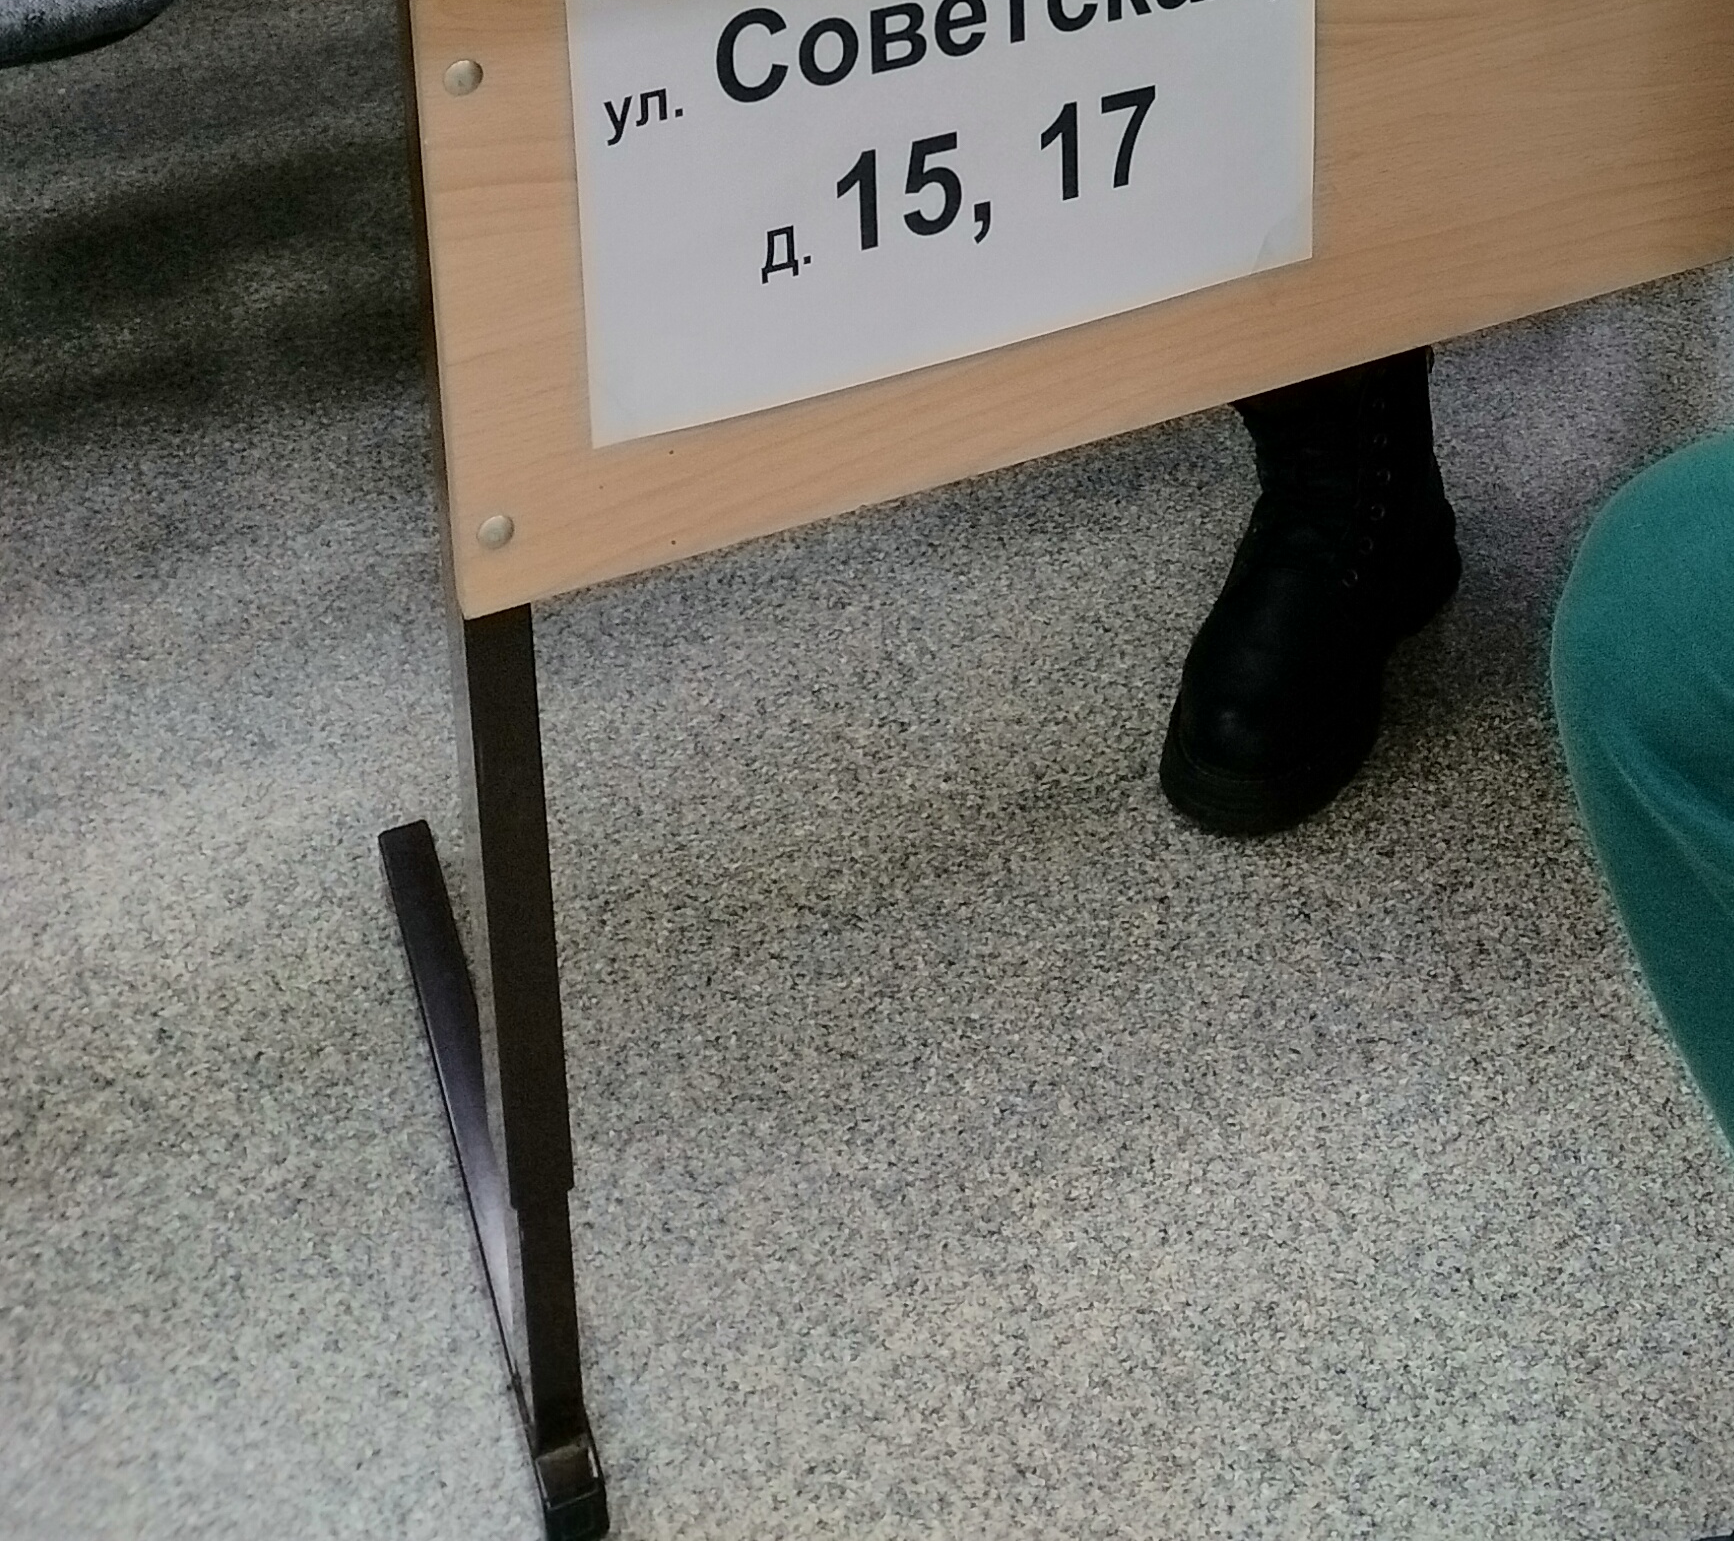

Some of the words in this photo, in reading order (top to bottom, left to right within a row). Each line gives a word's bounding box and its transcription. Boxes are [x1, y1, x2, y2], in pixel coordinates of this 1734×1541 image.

[603, 84, 684, 147] ул.
[761, 225, 812, 284] д.
[836, 131, 992, 251] 15,
[1040, 85, 1157, 201] 17
